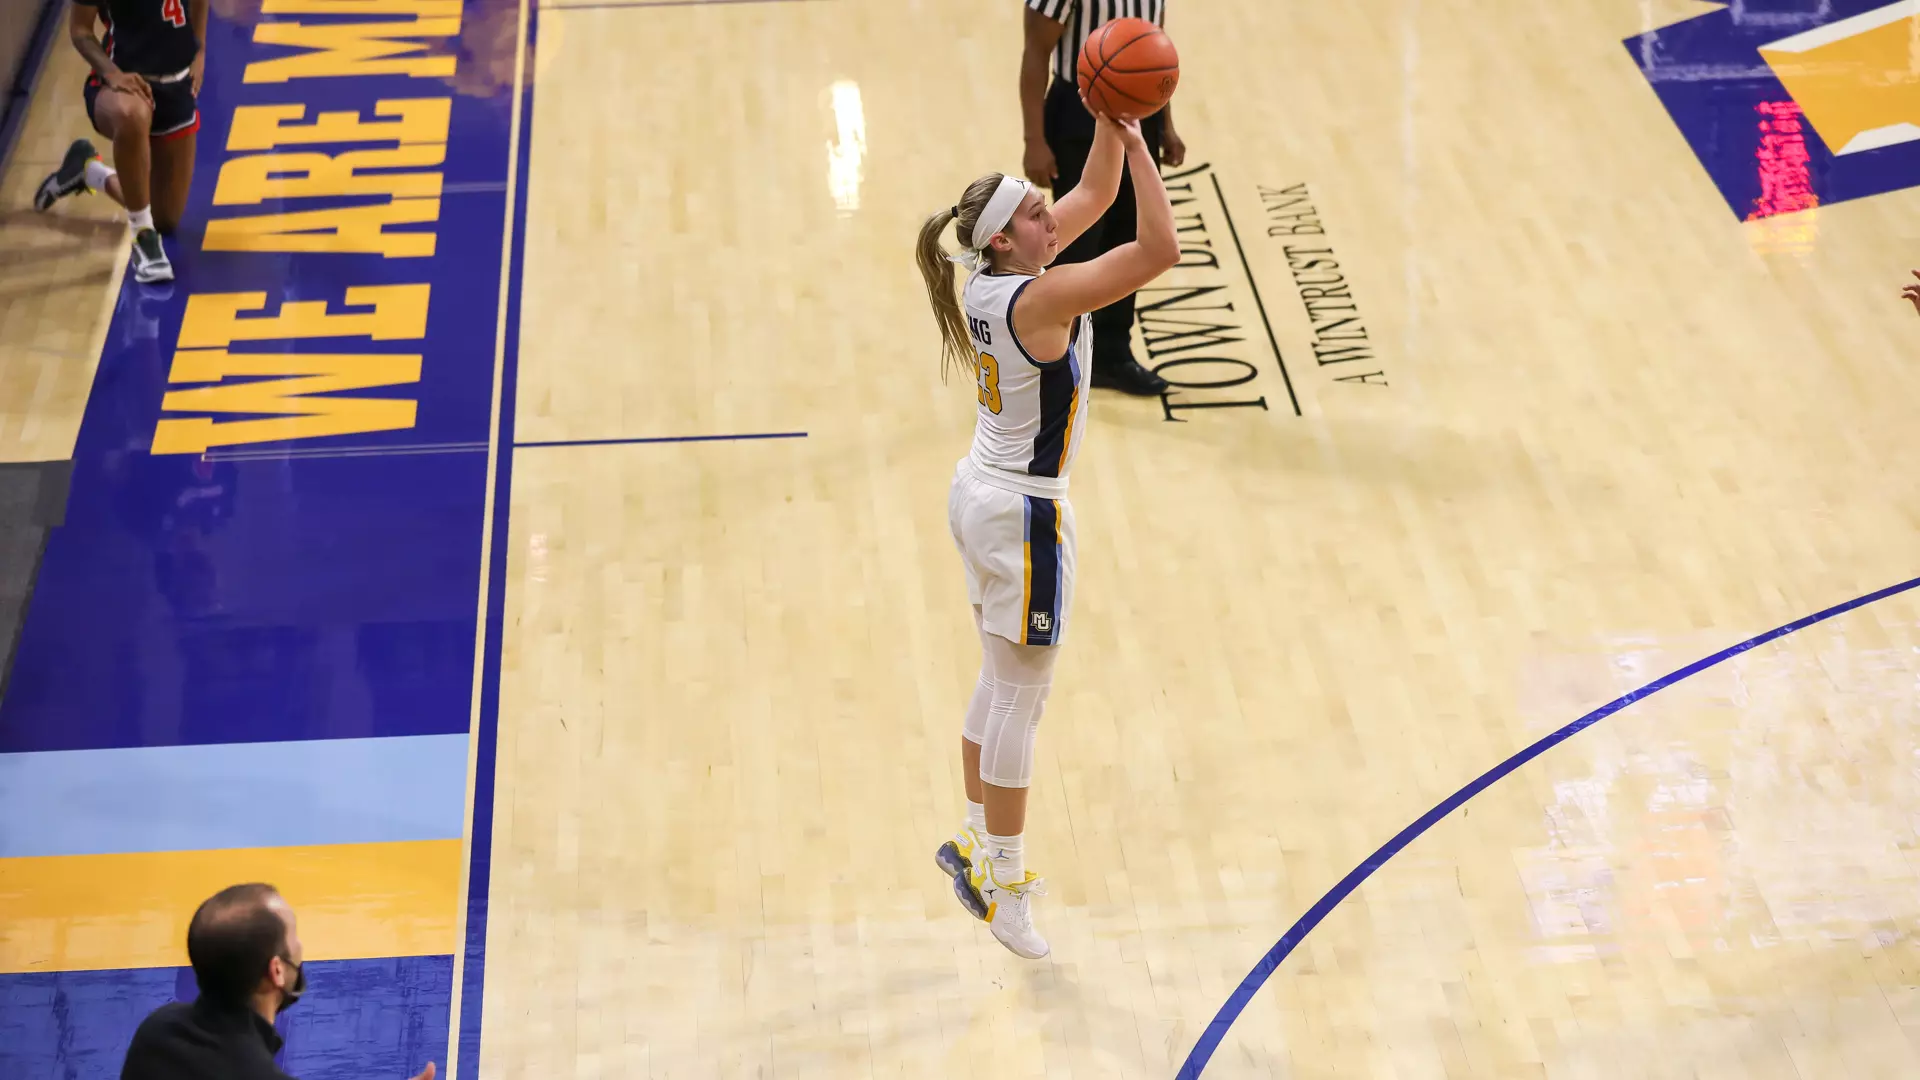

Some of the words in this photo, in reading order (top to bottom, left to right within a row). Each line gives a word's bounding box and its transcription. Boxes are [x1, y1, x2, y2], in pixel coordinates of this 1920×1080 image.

[162, 0, 186, 28] 4
[201, 97, 452, 258] ARE
[1257, 182, 1325, 237] BANK
[1283, 245, 1376, 366] WINTRUST
[150, 283, 431, 456] WE
[1133, 286, 1268, 422] TOWN
[1332, 370, 1389, 387] A
[1031, 612, 1052, 631] MU
